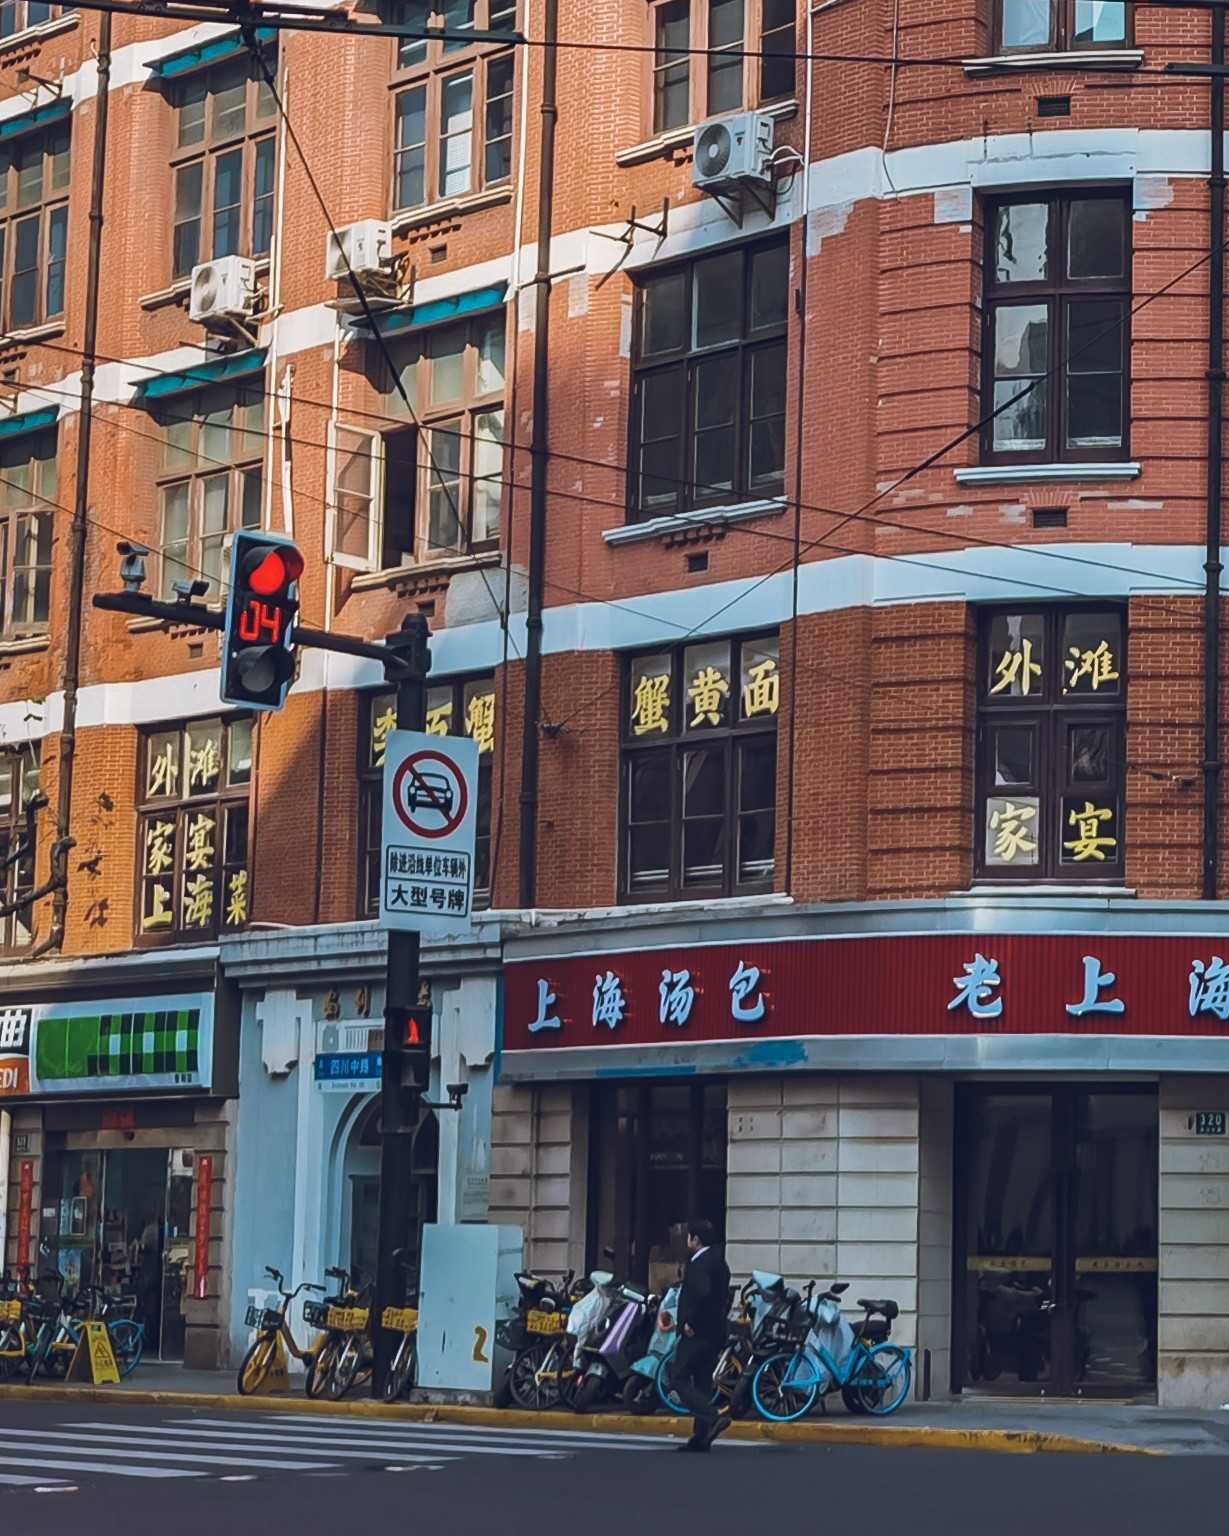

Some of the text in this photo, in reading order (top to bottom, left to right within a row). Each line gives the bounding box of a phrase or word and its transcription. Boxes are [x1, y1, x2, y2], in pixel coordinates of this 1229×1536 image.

[240, 600, 280, 643] 04
[632, 660, 780, 735] 蟹黄面
[990, 640, 1121, 696] 外滩
[149, 738, 220, 797] 外滩
[148, 813, 216, 875] 家宴
[989, 801, 1117, 862] 家宴
[143, 869, 248, 930] 上海菜
[391, 883, 466, 912] 大型号牌
[528, 960, 765, 1034] 上海汤包
